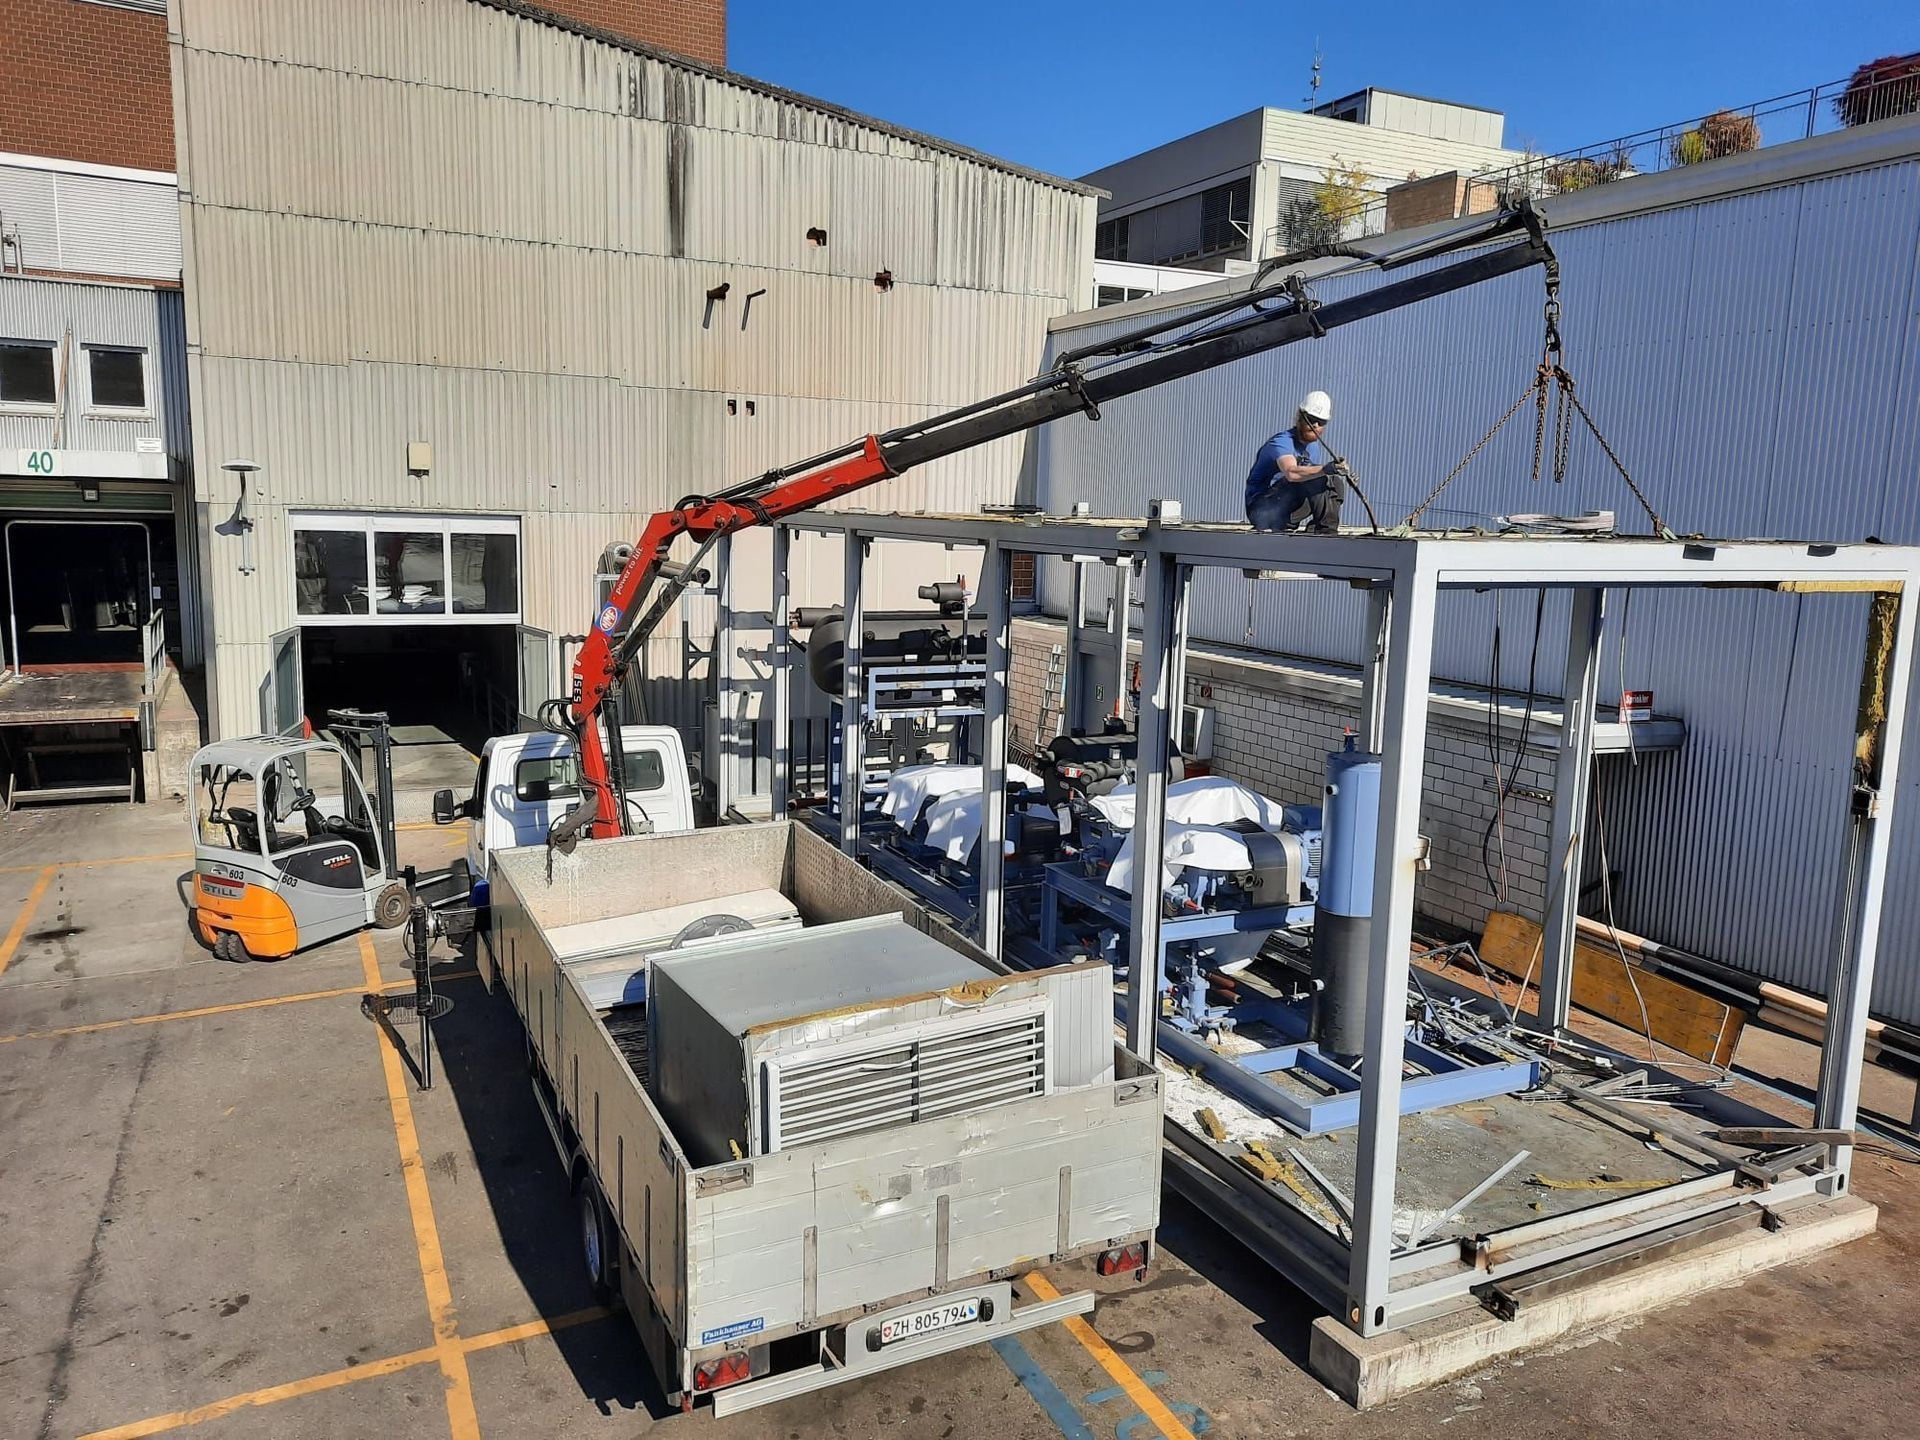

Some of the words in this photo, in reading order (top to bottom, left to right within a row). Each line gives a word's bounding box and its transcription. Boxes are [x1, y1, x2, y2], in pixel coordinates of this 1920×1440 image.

[27, 451, 54, 474] 40
[616, 571, 631, 595] power
[628, 560, 636, 569] to
[573, 680, 582, 702] 535
[322, 854, 352, 866] STILL
[228, 869, 244, 880] 603
[281, 874, 298, 888] 603
[203, 884, 237, 897] STILL
[893, 1319, 909, 1337] ZH
